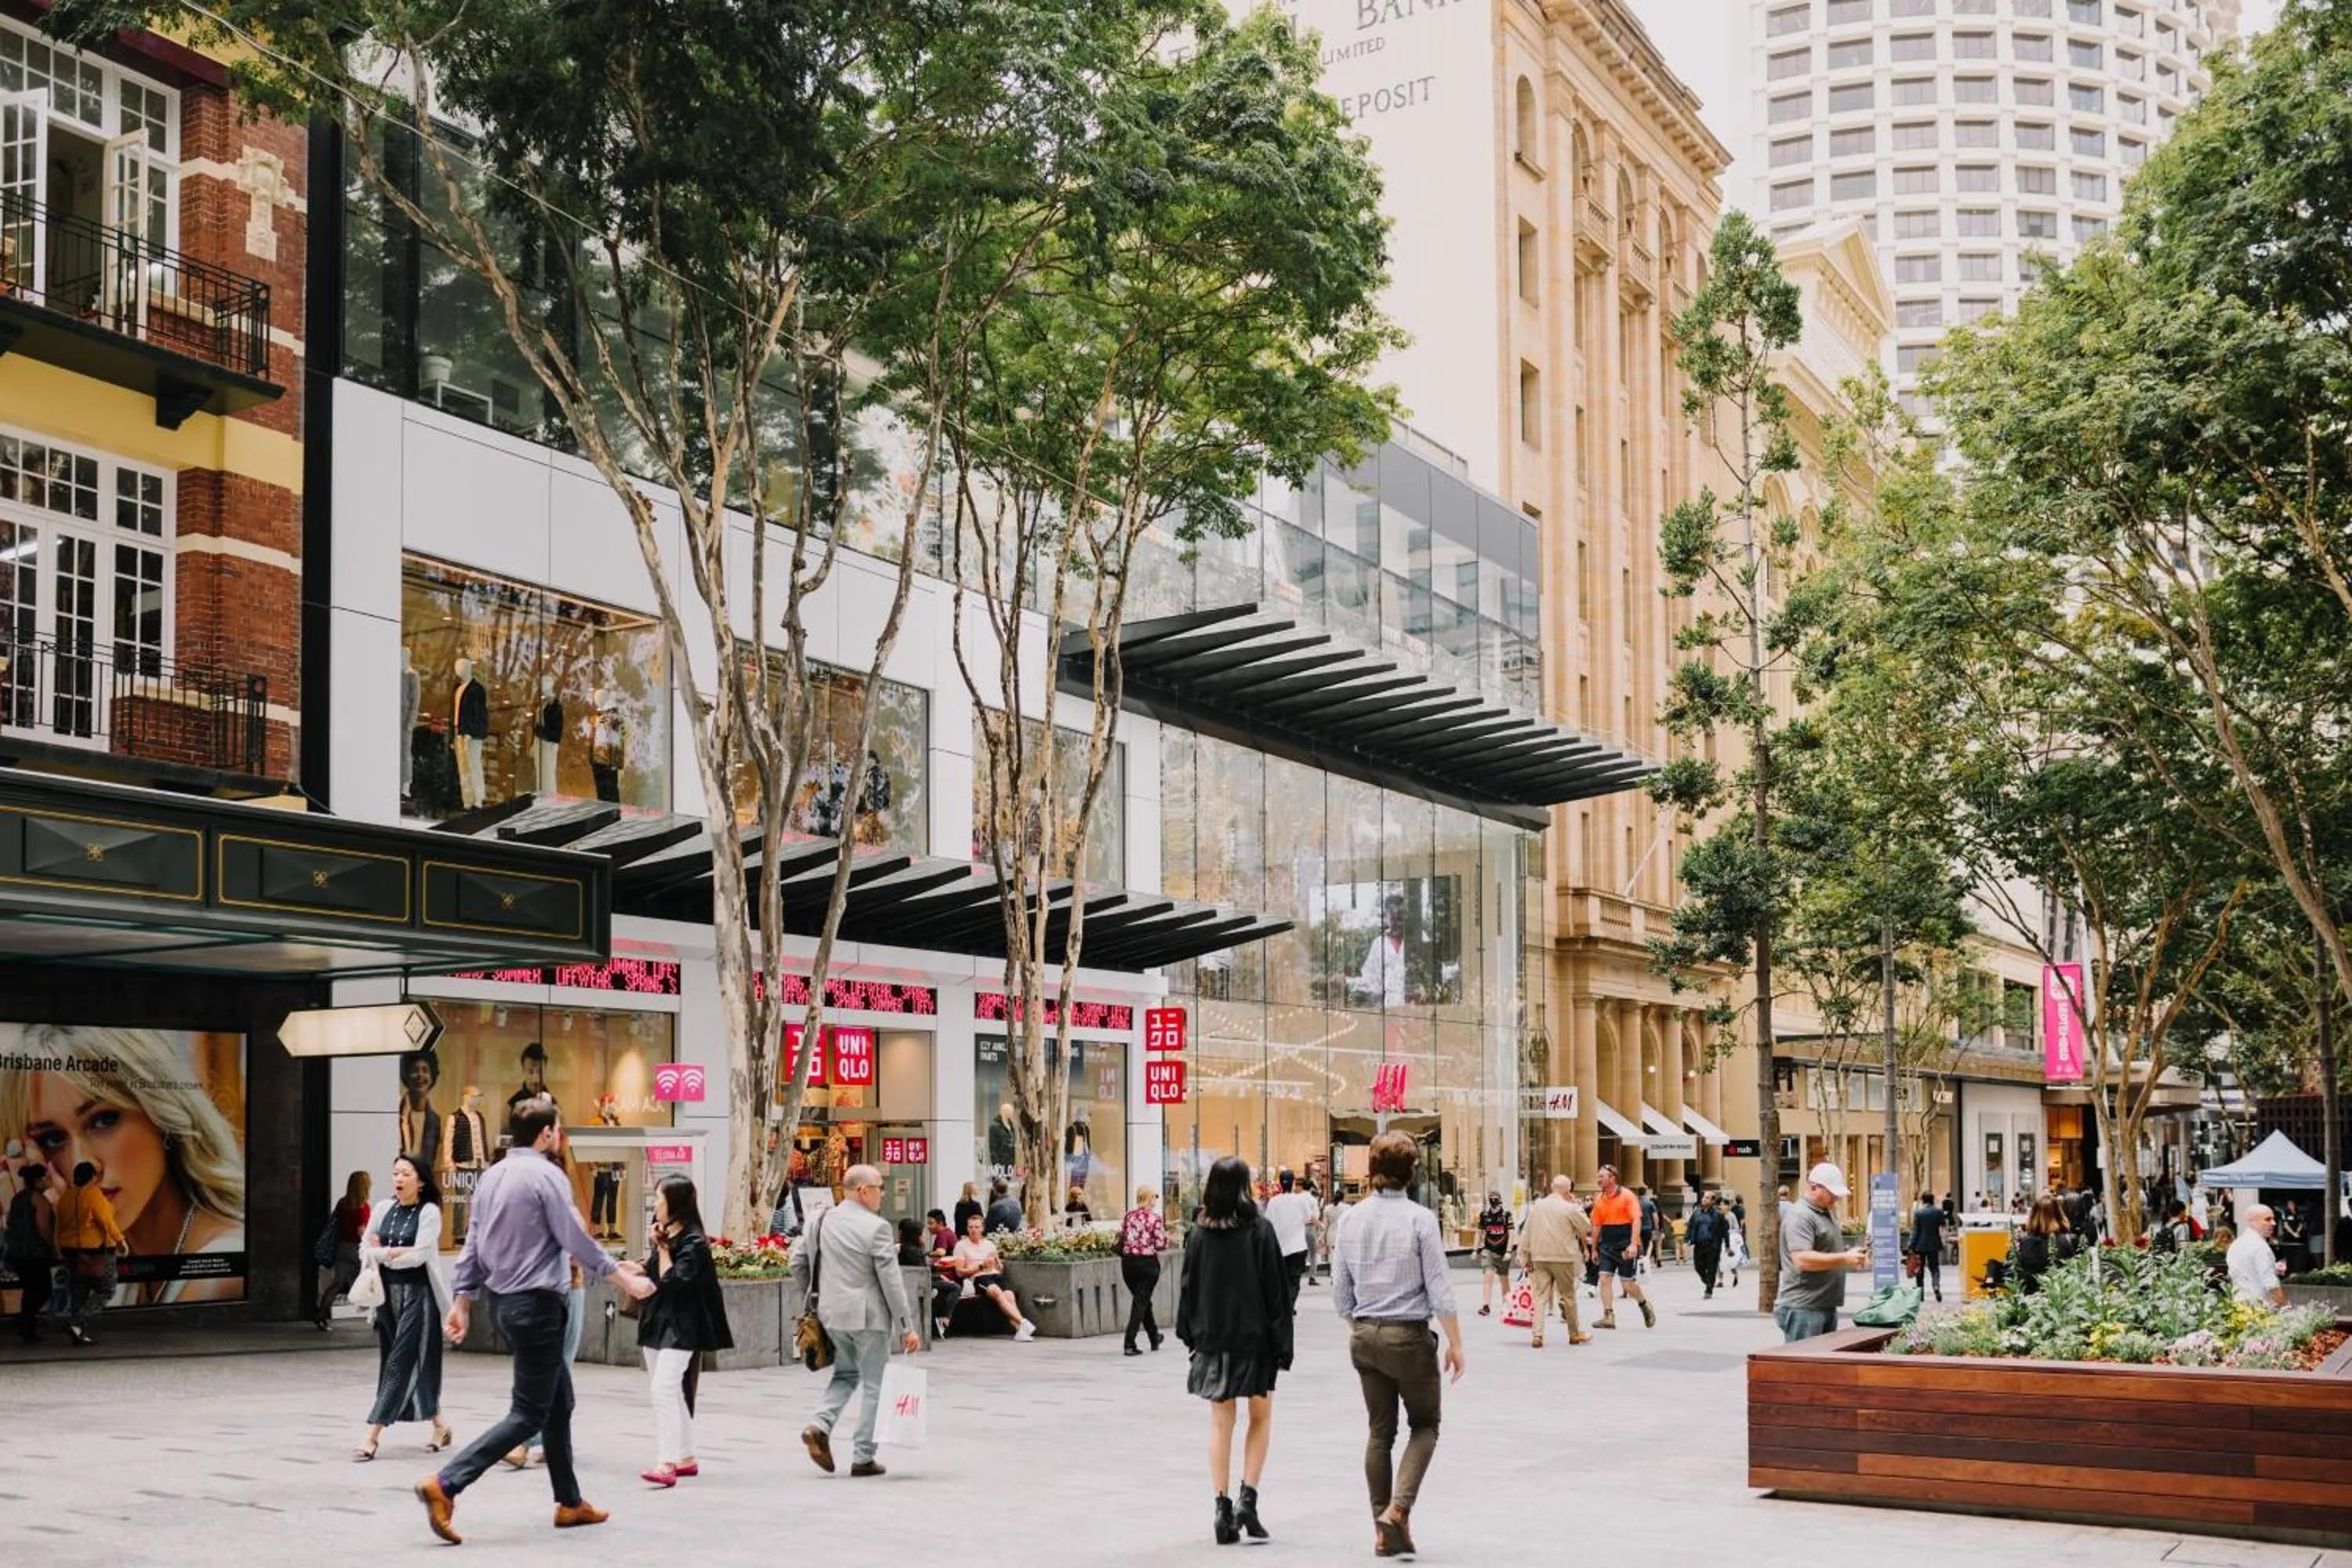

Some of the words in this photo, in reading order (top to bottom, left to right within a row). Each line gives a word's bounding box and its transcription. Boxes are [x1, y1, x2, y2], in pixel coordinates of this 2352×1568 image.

[1356, 0, 1461, 30] BA
[1322, 37, 1385, 65] LIMITED
[1341, 76, 1436, 121] EPOSIT
[839, 1034, 866, 1056] UNI
[0, 1054, 62, 1071] risbane
[66, 1055, 118, 1073] Arcade
[839, 1058, 869, 1082] QLO
[1150, 1065, 1177, 1081] UNI
[1150, 1083, 1178, 1102] QLO
[1549, 1093, 1573, 1110] H&M
[441, 1171, 478, 1191] UNIQ
